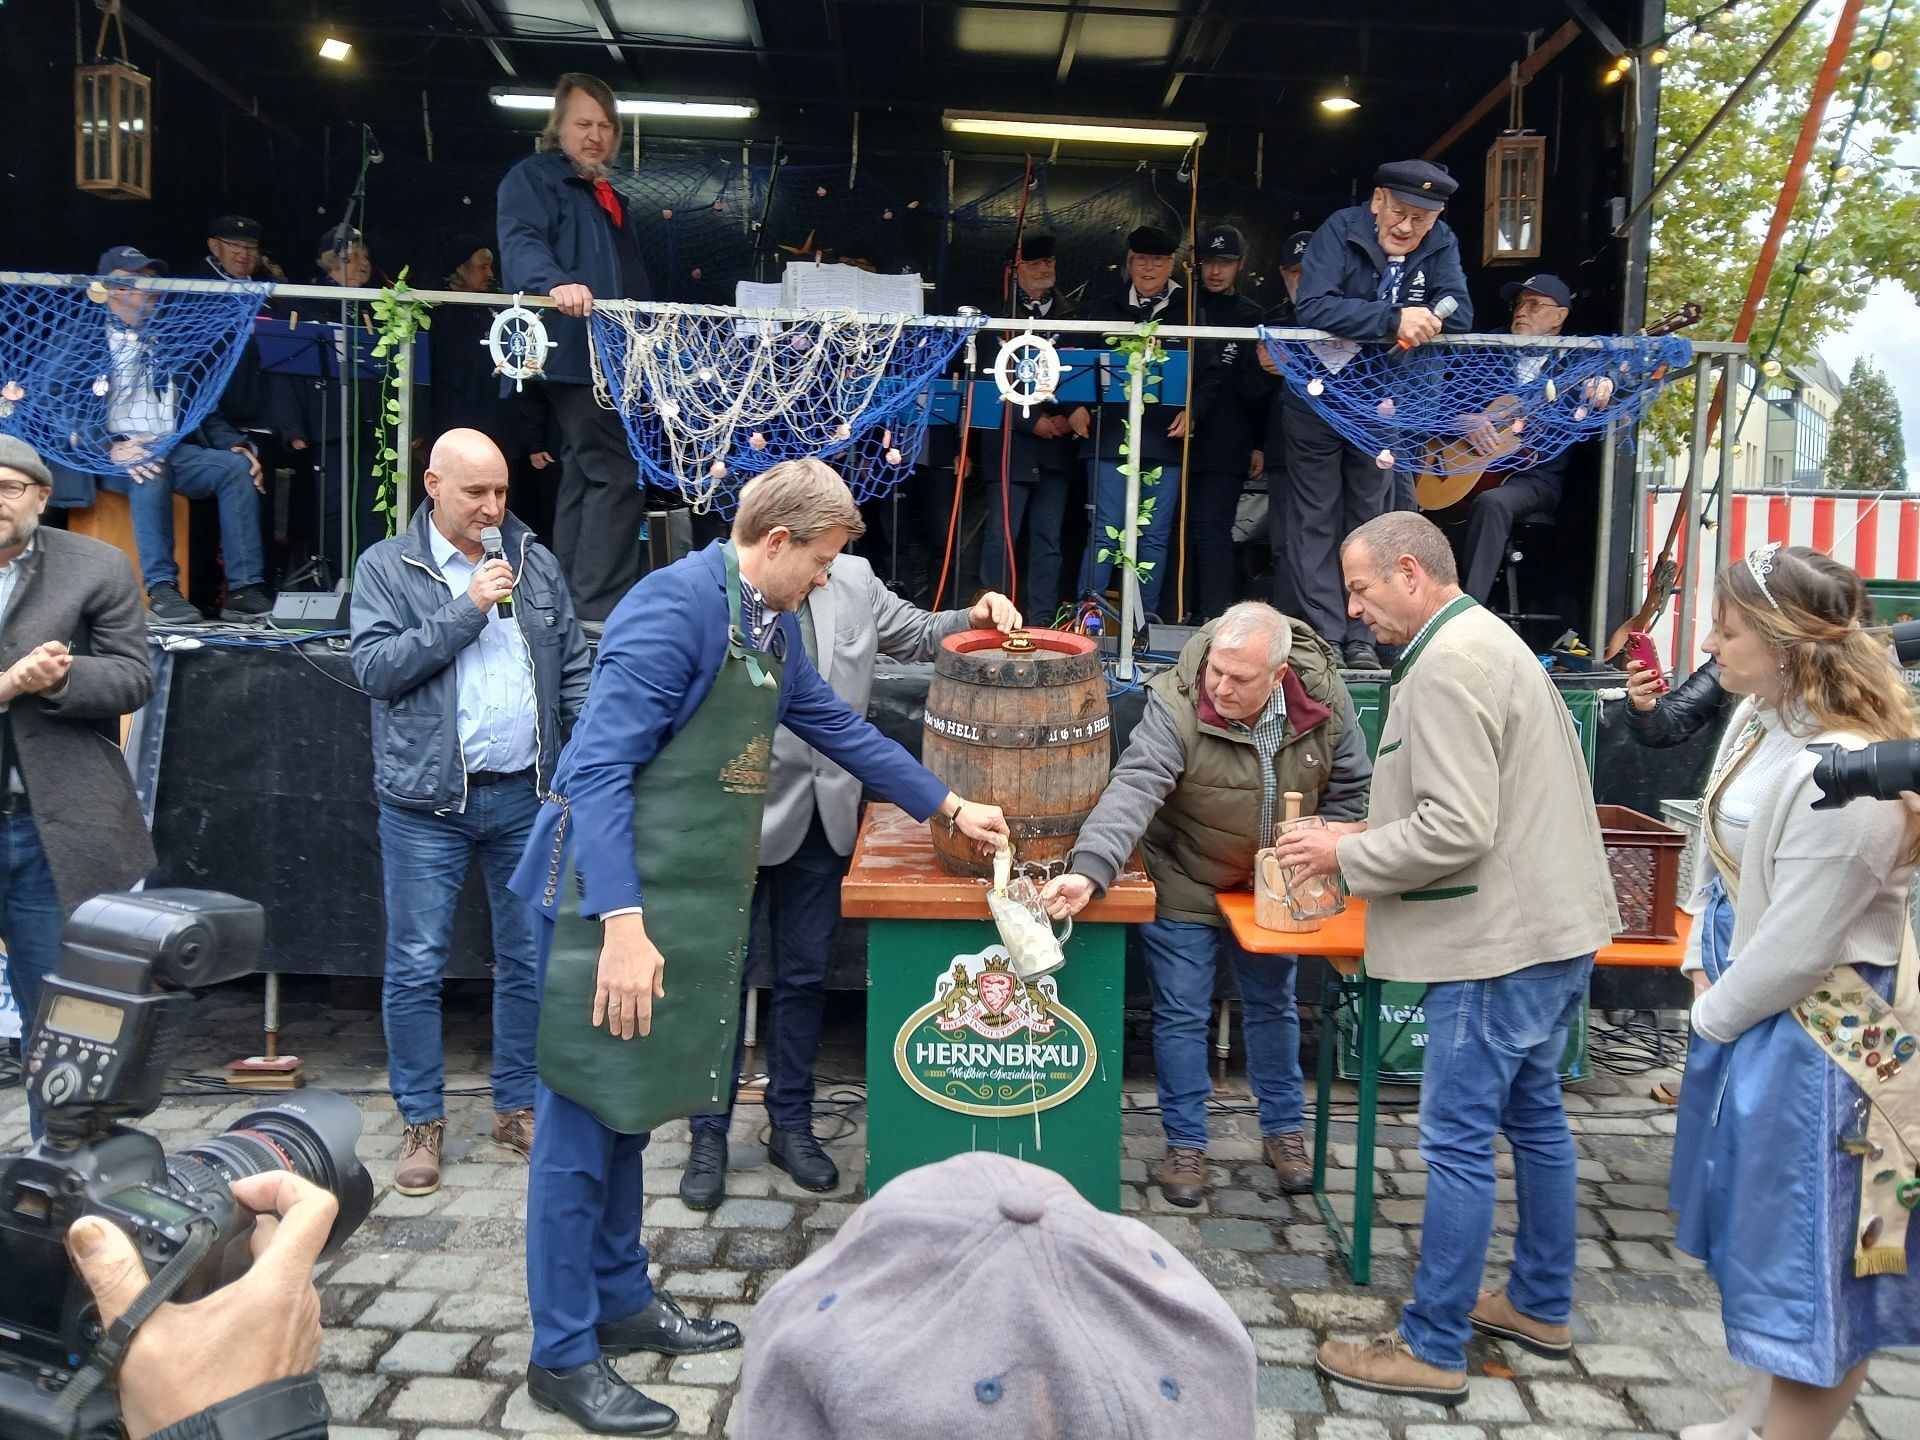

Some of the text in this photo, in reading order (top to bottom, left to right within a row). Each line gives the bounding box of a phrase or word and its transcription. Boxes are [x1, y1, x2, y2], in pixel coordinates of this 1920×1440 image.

[946, 720, 980, 741] HELL
[943, 1006, 979, 1030] PREMIUM
[969, 1019, 1022, 1037] INGOLSTADT
[916, 1042, 1079, 1068] HERRNBRÄU
